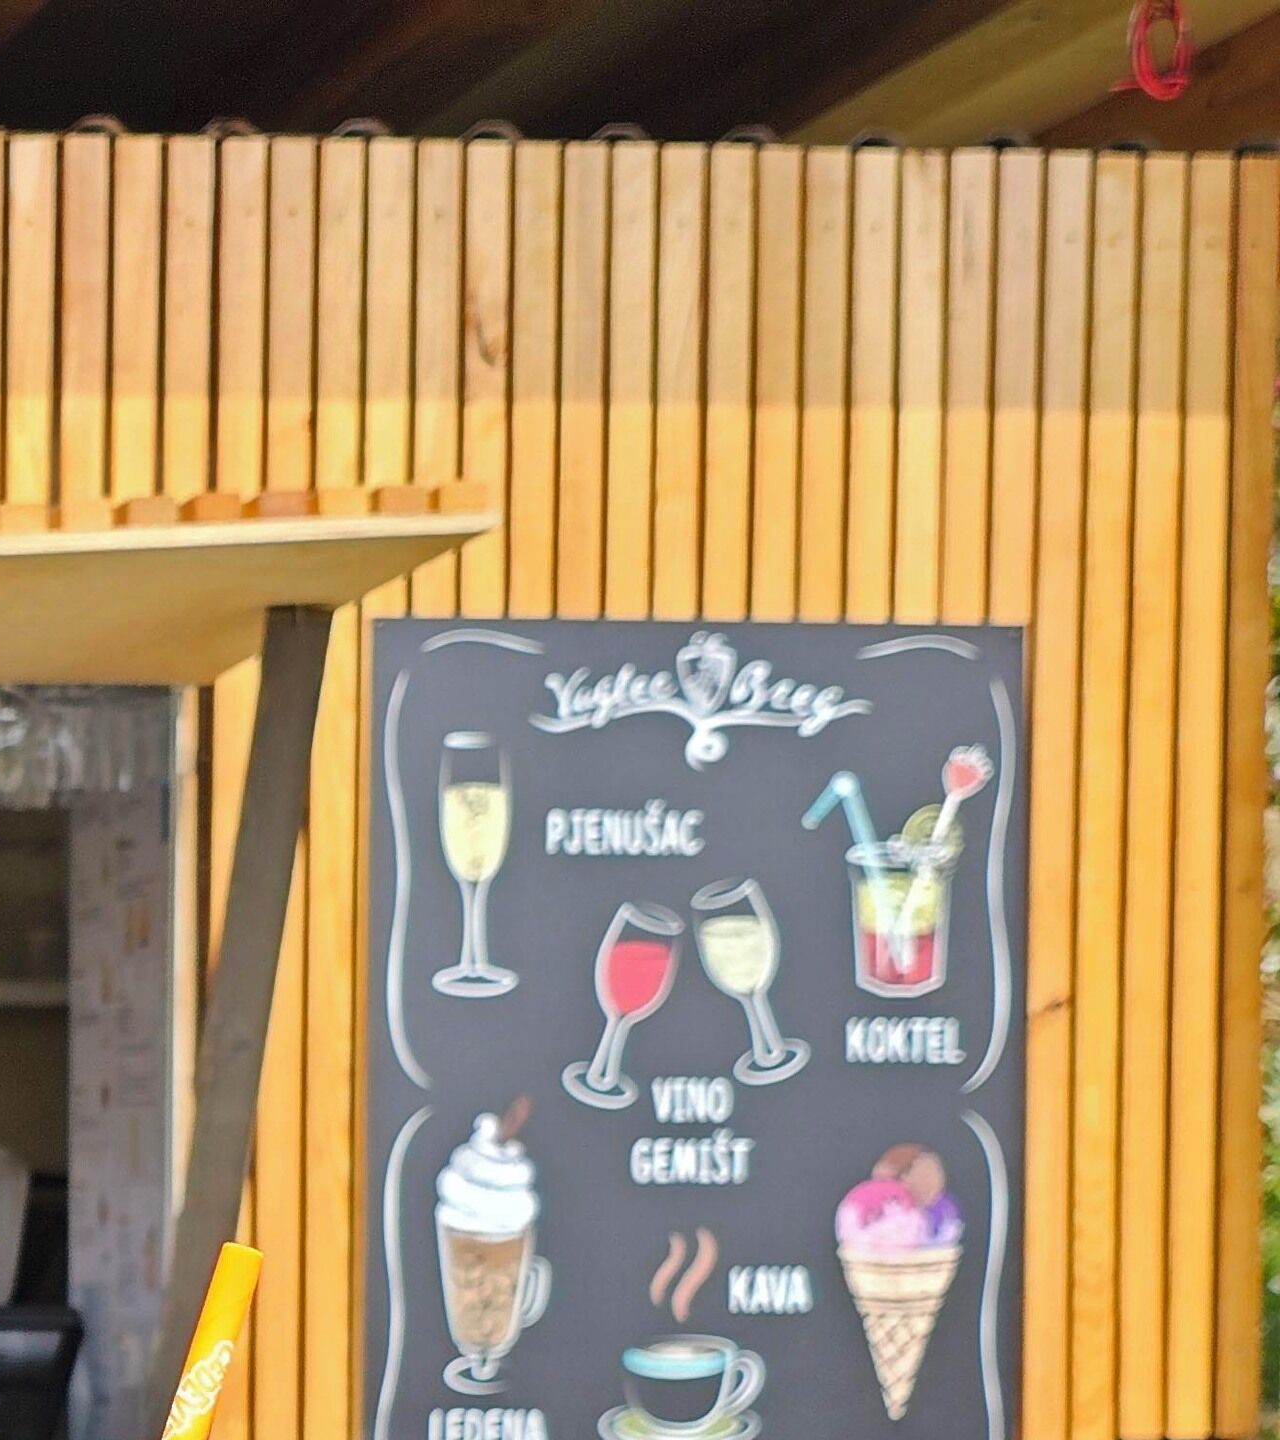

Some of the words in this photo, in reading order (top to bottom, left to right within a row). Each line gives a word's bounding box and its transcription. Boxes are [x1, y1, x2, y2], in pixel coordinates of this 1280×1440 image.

[545, 798, 706, 857] PJENUŠAC
[845, 1015, 968, 1065] KOKTEL
[651, 1075, 735, 1124] VINO
[630, 1127, 757, 1185] GEMIŠT
[727, 1264, 814, 1315] KAVA
